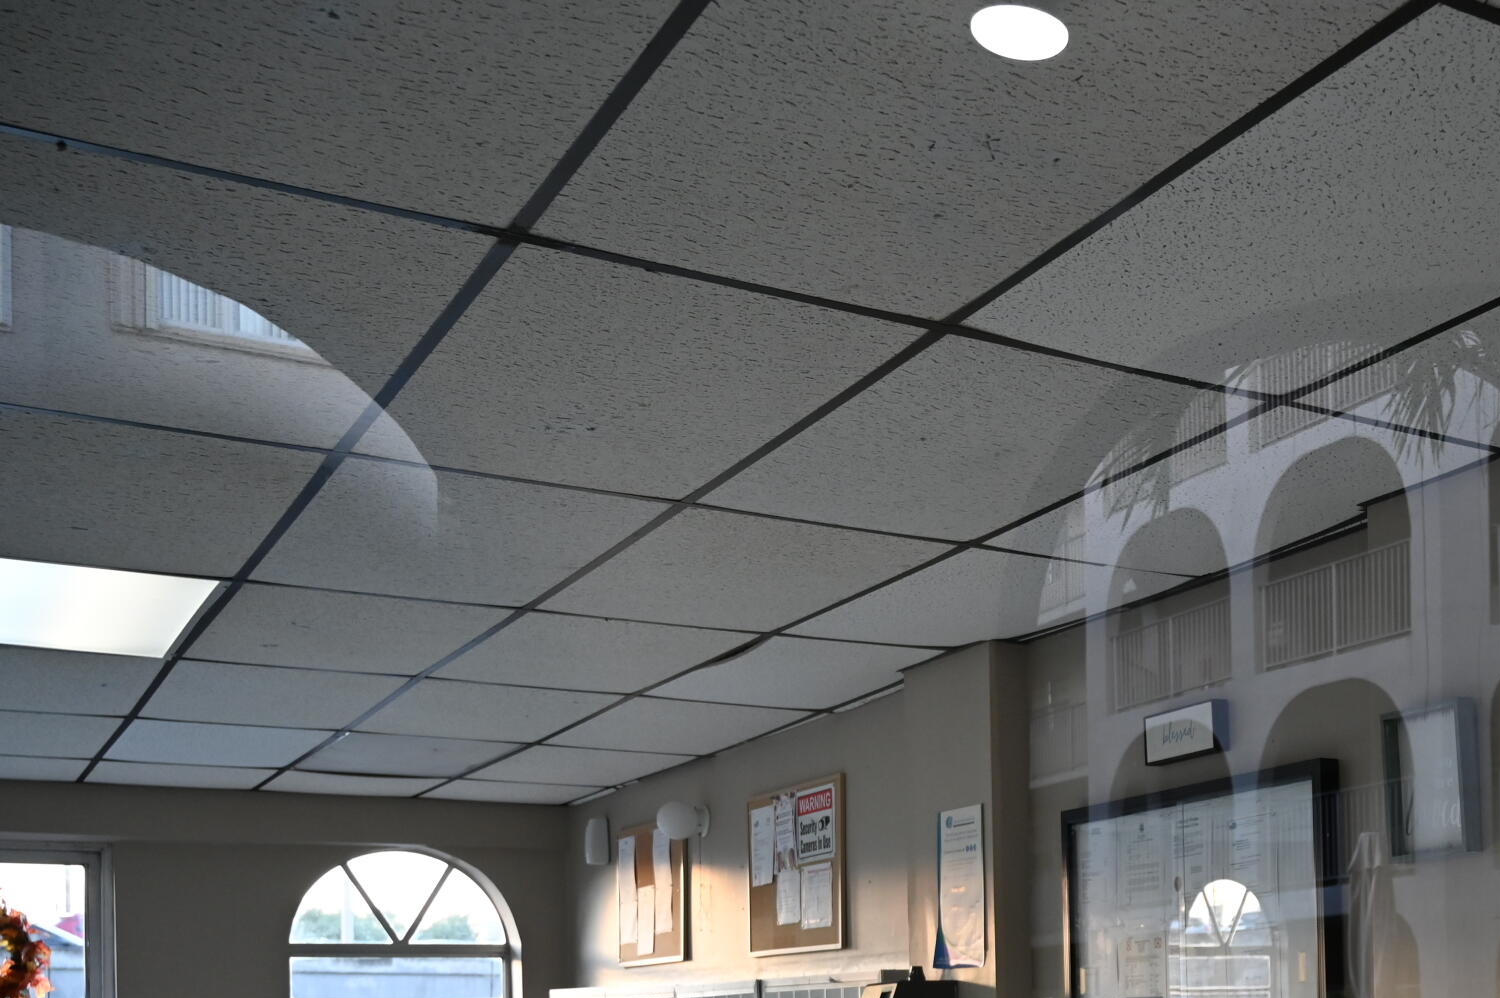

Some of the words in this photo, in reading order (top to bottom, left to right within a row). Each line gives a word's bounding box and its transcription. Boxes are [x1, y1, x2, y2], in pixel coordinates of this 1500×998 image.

[1162, 719, 1195, 745] blessed
[799, 793, 832, 813] WARNING
[800, 818, 818, 836] Security
[800, 837, 818, 854] Cameras
[818, 836, 822, 849] In
[823, 835, 831, 849] Use
